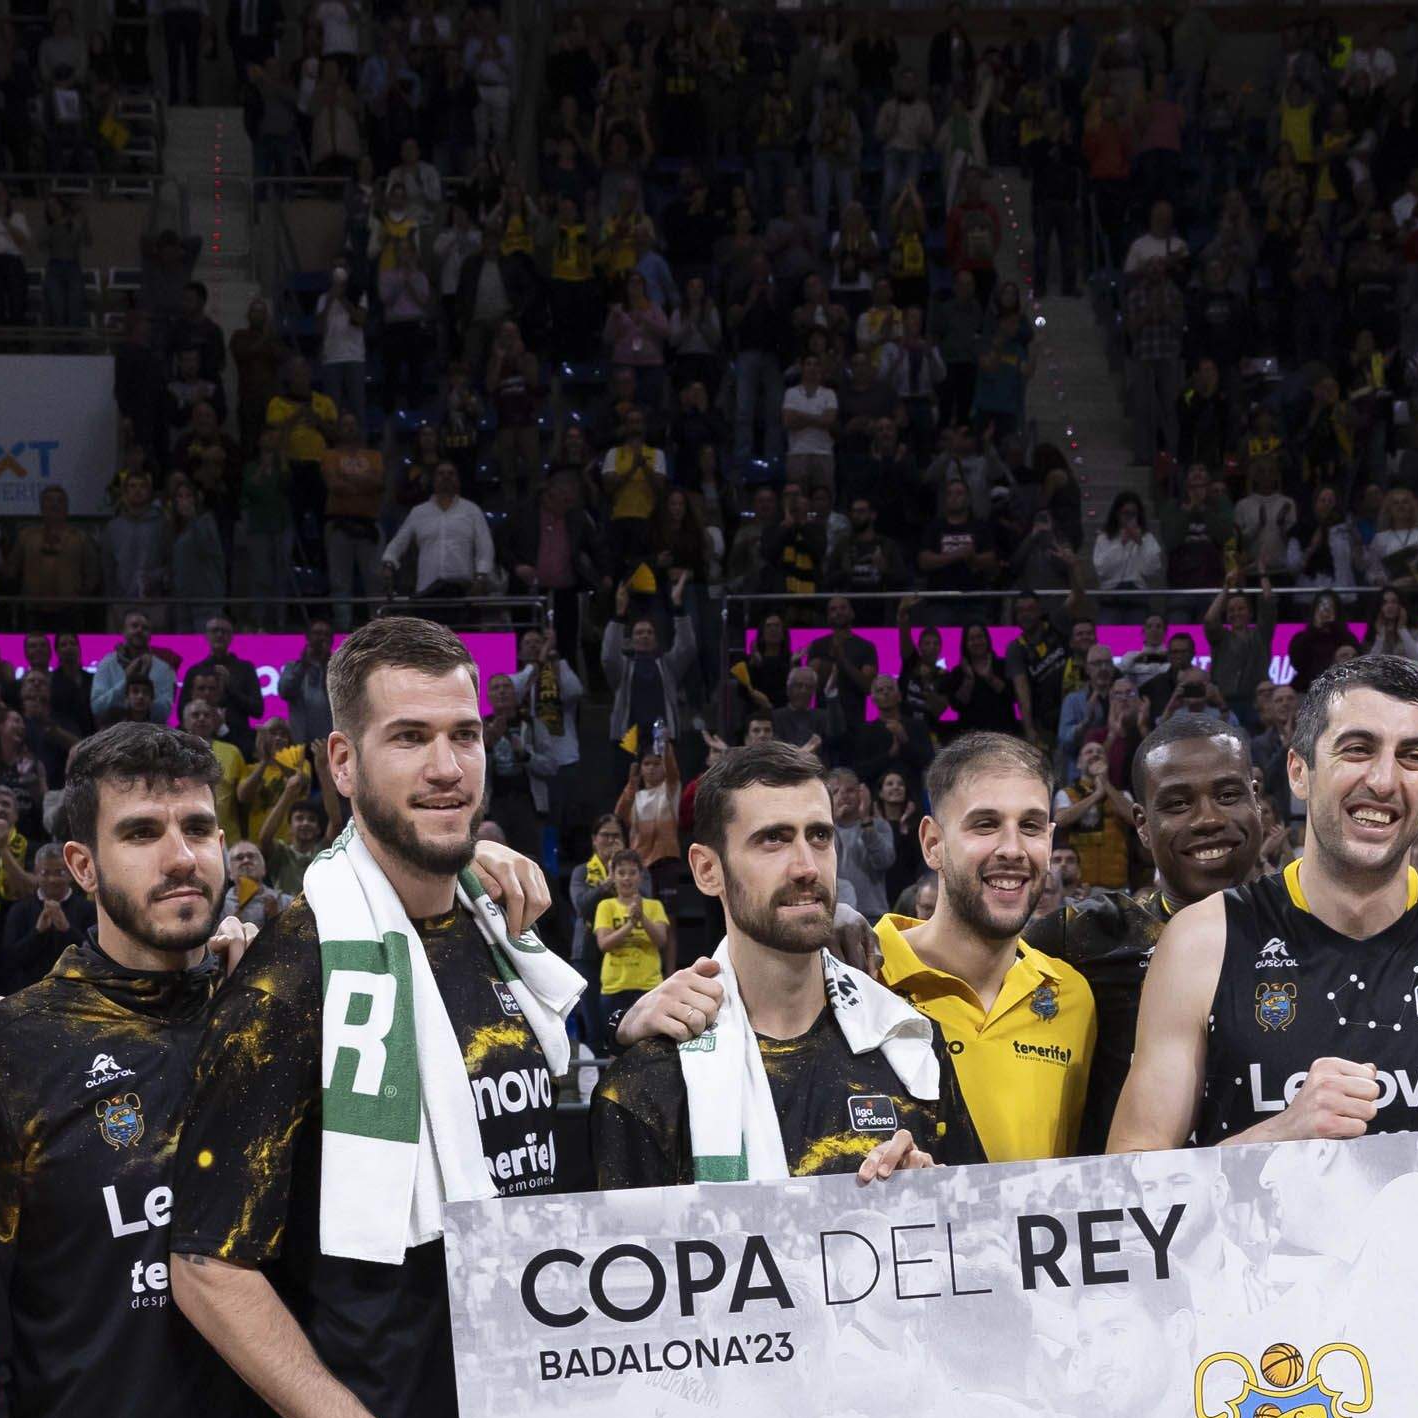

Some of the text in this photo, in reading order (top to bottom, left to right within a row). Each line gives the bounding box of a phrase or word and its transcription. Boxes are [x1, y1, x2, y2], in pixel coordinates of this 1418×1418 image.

[1013, 1039, 1072, 1063] tenerife!
[85, 1069, 135, 1088] austral
[473, 1068, 551, 1120] novo
[855, 1107, 873, 1119] liga
[857, 1115, 894, 1126] endesa
[520, 1203, 1187, 1329] COPA DEL REY
[539, 1331, 795, 1381] BADALONA'23
